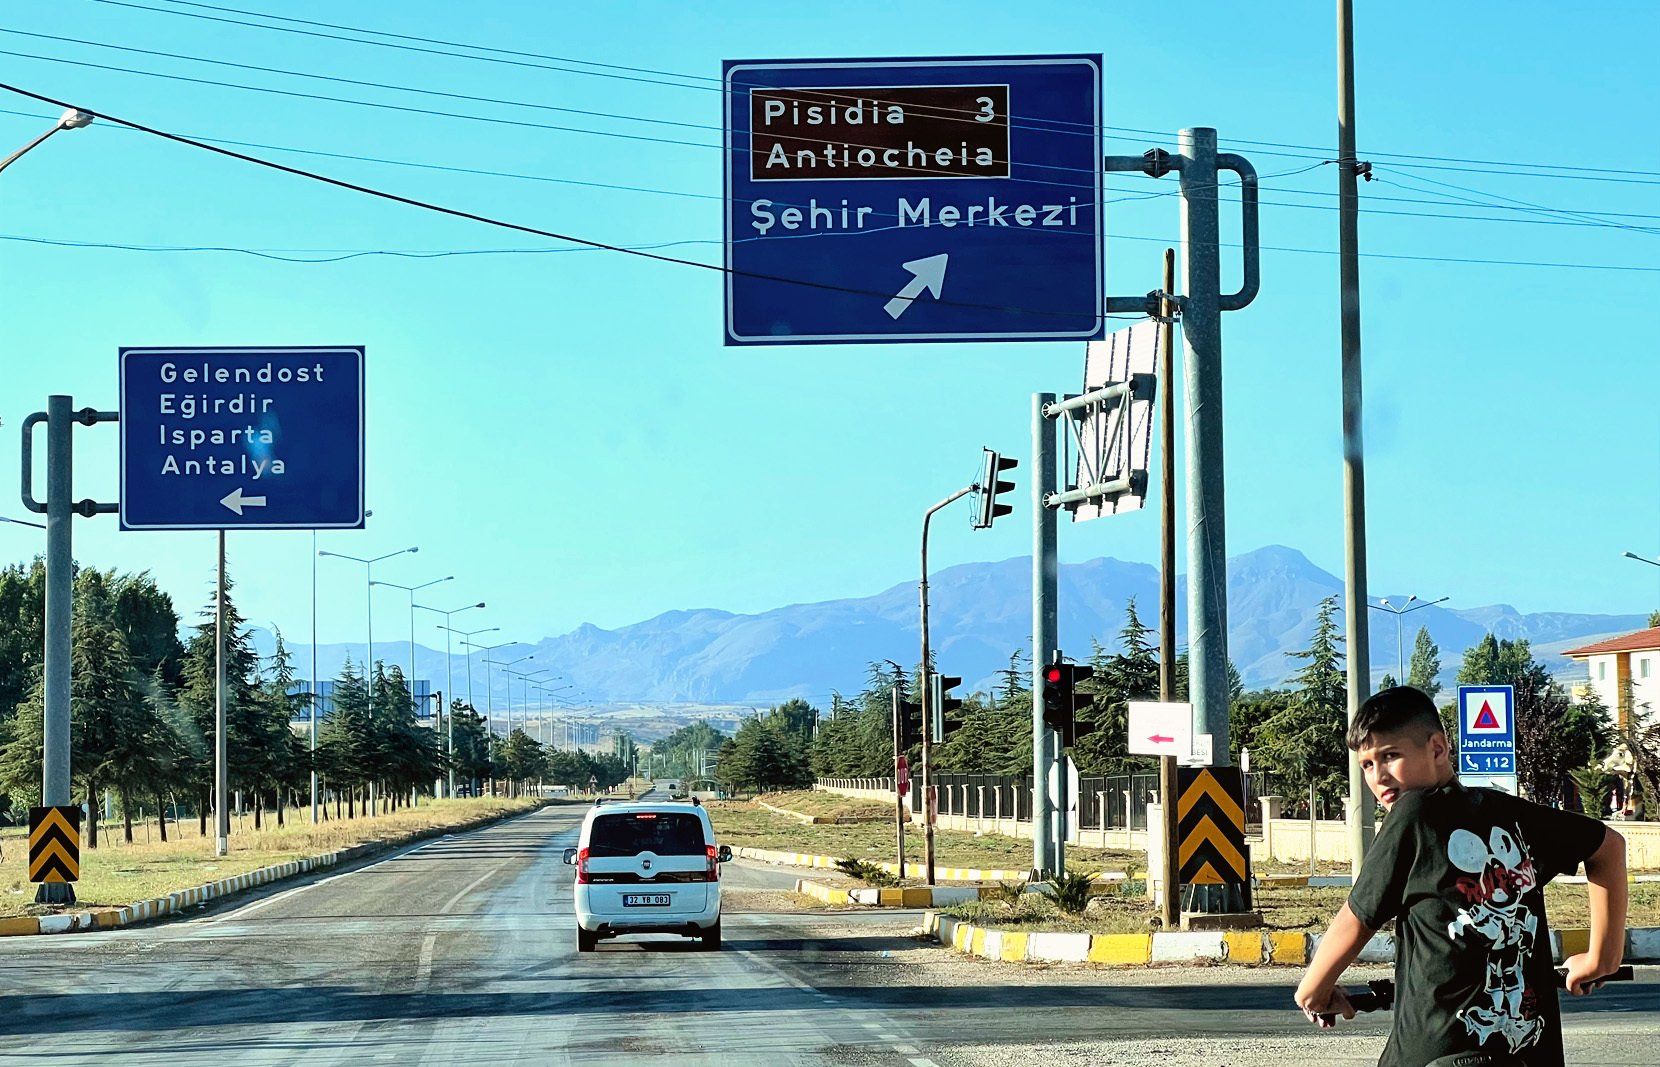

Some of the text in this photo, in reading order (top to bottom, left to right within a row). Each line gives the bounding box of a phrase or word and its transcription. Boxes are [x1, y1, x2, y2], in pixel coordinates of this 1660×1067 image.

[764, 96, 995, 126] Pisidia 3
[765, 141, 994, 169] Antiocheia
[750, 196, 1077, 235] Şehir Merkezi
[160, 362, 325, 383] Gelendost
[160, 393, 274, 419] Eğirdir
[160, 424, 274, 450] Isparta
[161, 454, 286, 480] Antalya
[1462, 738, 1513, 748] Jandarma
[1485, 757, 1509, 768] 112
[629, 896, 638, 904] 32
